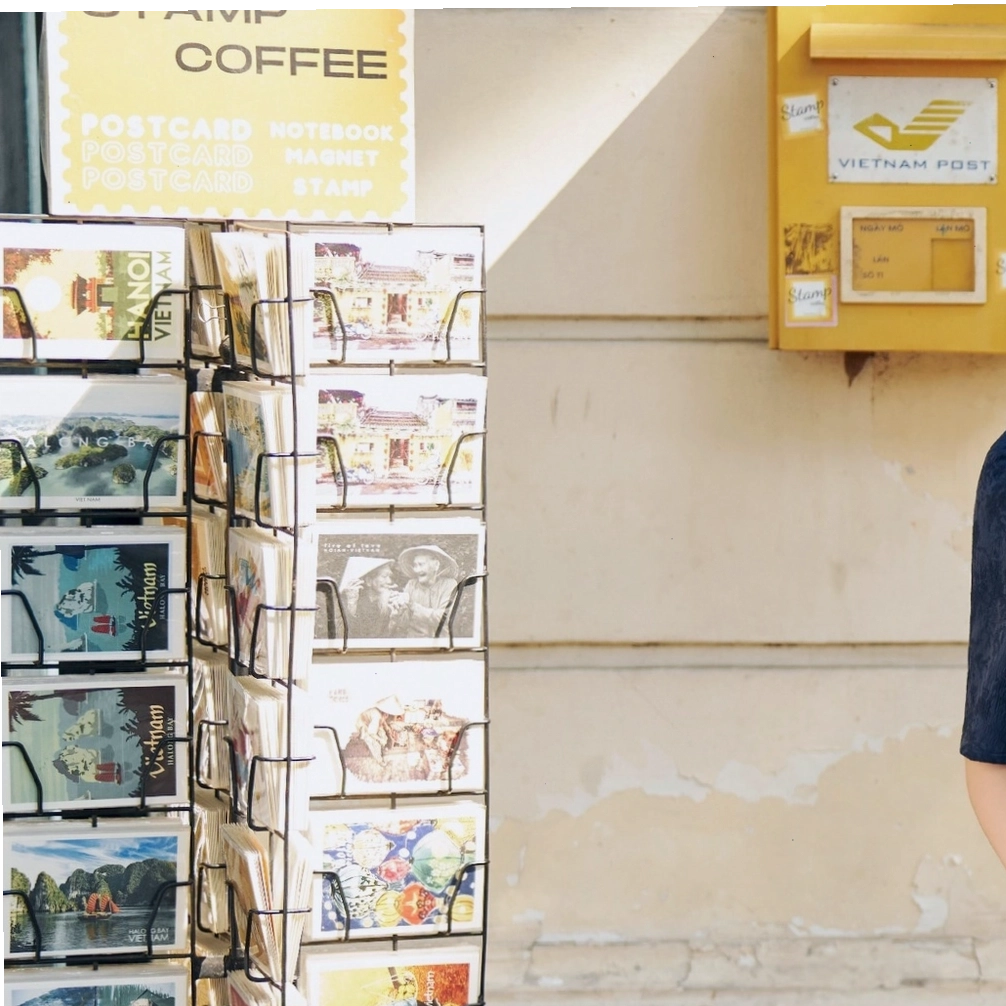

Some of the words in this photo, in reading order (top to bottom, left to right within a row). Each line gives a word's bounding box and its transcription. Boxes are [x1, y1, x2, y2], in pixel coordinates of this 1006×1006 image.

[175, 42, 388, 80] COFFEE
[781, 100, 824, 121] Stamp
[81, 112, 253, 142] POSTCARD
[269, 120, 394, 142] NOTEBOOK
[81, 140, 253, 168] POSTCARD
[285, 147, 379, 167] MAGNET
[838, 158, 927, 169] VIETNAM
[937, 159, 991, 171] POST
[82, 166, 254, 194] POSTCARD
[293, 177, 373, 198] STAMP
[788, 287, 832, 304] Stamp
[127, 436, 169, 448] BA
[167, 733, 175, 766] HALOG
